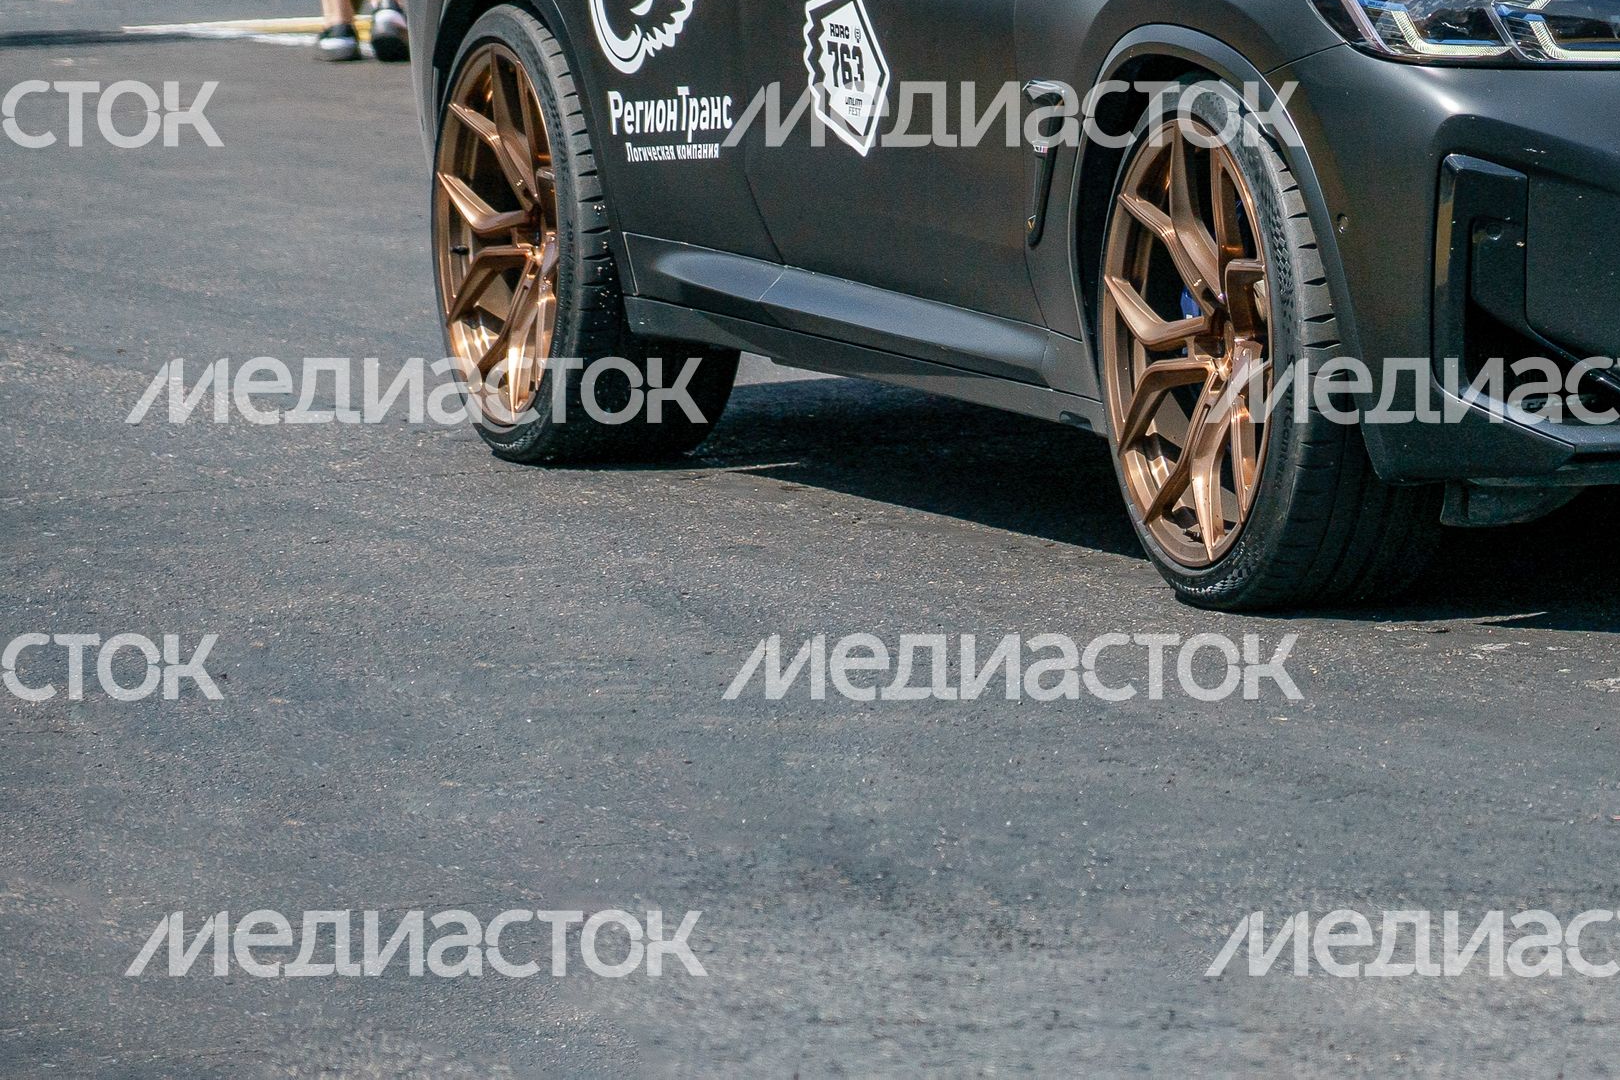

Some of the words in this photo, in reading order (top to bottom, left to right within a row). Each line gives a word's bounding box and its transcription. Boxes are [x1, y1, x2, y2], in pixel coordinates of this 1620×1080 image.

[829, 23, 850, 39] RDRC
[827, 40, 865, 93] 763
[676, 143, 720, 160] компания
